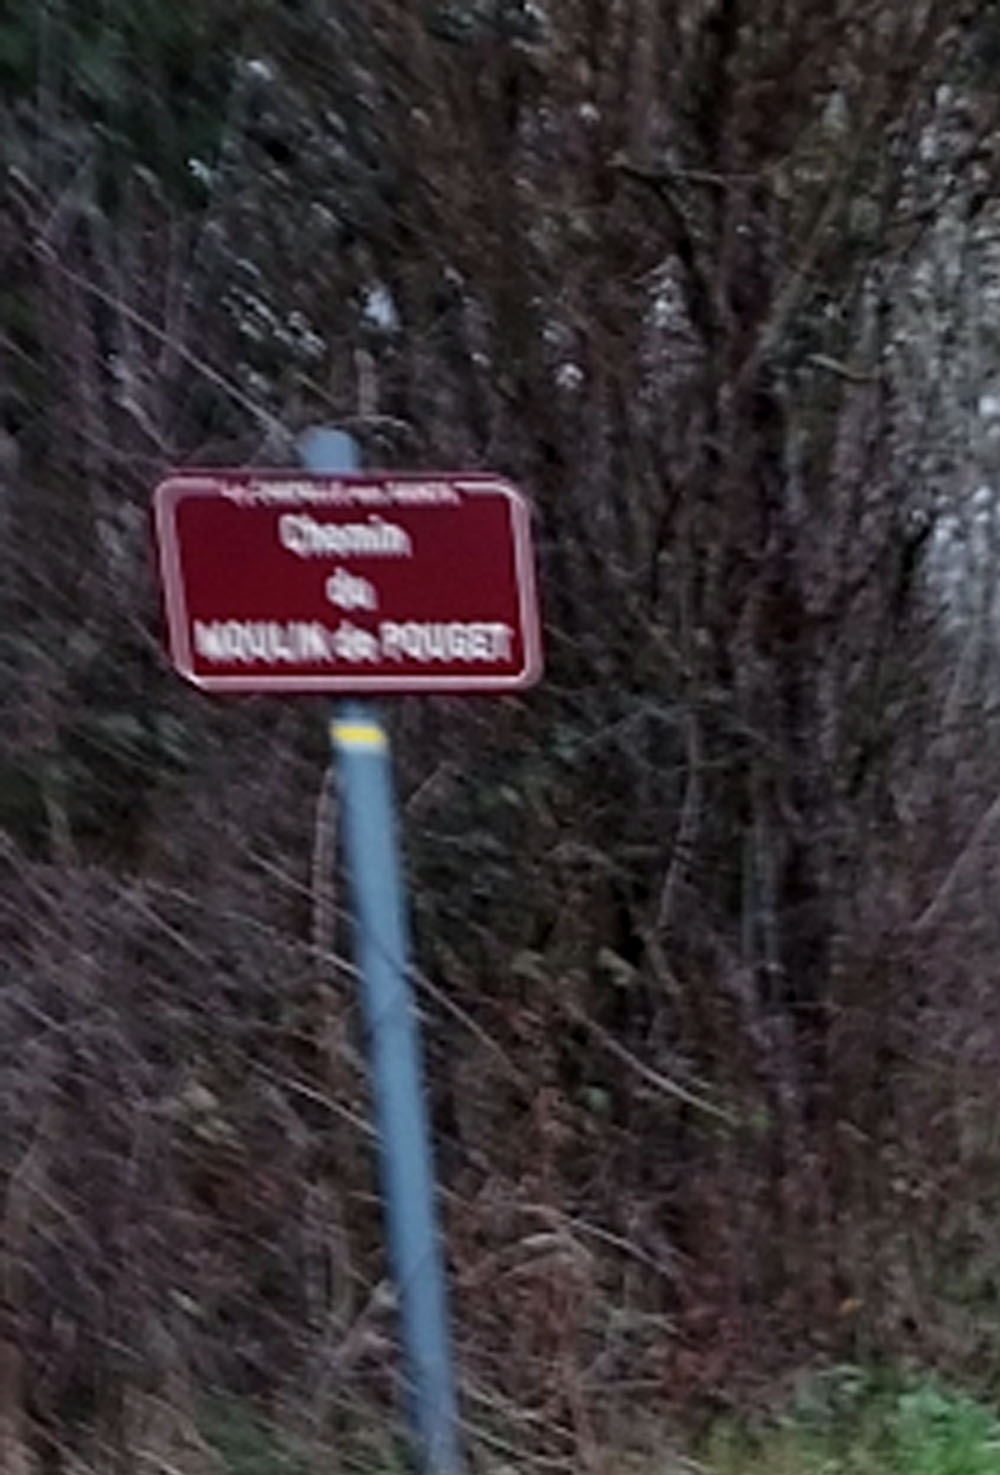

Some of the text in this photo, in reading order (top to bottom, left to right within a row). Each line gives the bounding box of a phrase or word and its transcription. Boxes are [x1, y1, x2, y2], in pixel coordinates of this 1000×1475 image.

[279, 513, 413, 558] Chemin
[194, 619, 515, 664] MOULIN de POUGET
